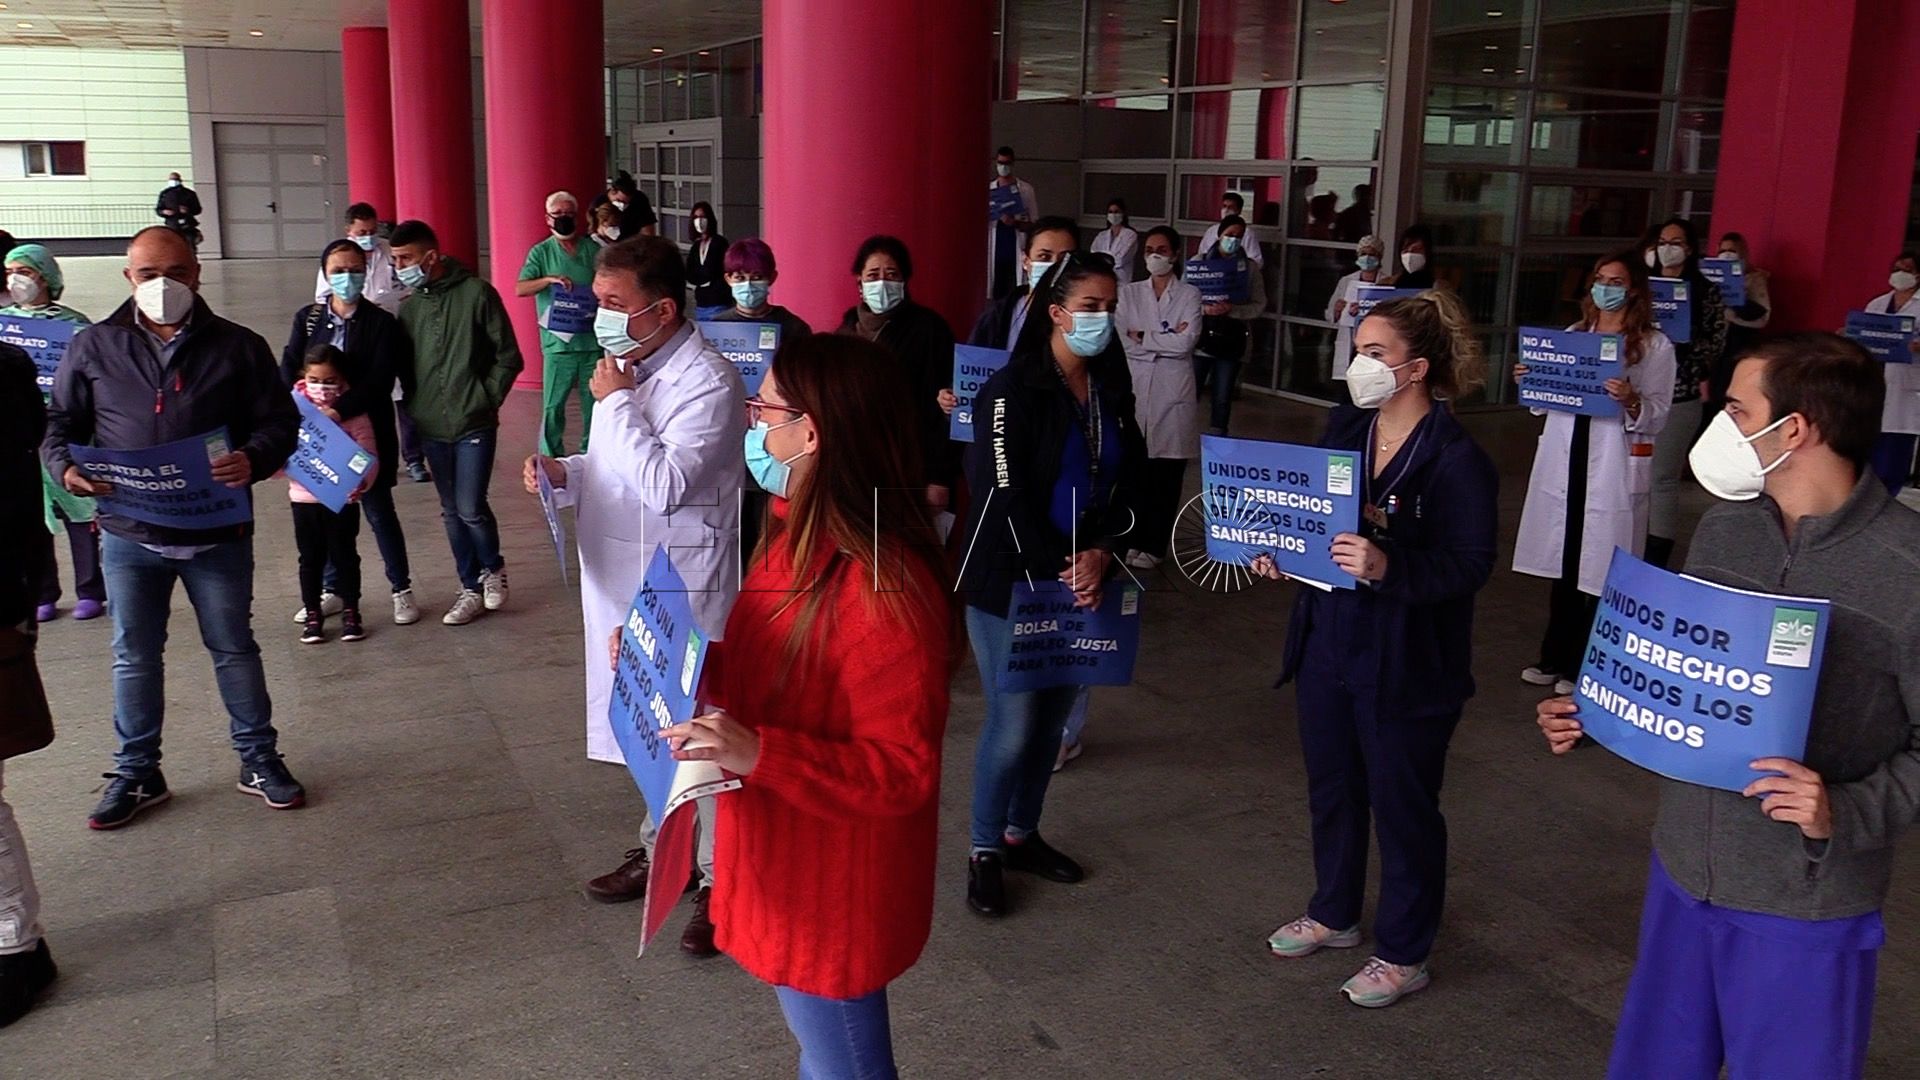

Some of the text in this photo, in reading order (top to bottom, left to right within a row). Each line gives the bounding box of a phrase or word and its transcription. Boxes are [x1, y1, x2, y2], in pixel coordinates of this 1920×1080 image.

[5, 324, 24, 334] AL
[0, 336, 67, 350] LTRATO DE
[723, 339, 746, 348] POR
[1522, 336, 1555, 349] NO AL
[722, 352, 763, 362] ECHOS
[1523, 350, 1602, 366] MALTRATO DEL
[739, 366, 758, 376] OS
[961, 364, 995, 377] UNID
[1529, 365, 1597, 380] GESA A SUS
[1522, 376, 1609, 396] PROFESIONALES
[1522, 389, 1583, 407] SANITARIOS
[307, 421, 327, 442] UNA
[311, 441, 326, 455] DE
[993, 398, 1010, 488] HELLY HANSEN
[84, 463, 183, 477] CONTRA EL
[309, 457, 339, 485] JUSTA
[1208, 461, 1271, 482] UNIDOS
[1277, 470, 1310, 487] POR
[1210, 483, 1333, 515] LOS DERECHOS
[1210, 503, 1326, 535] DE TODOS LOS
[1211, 525, 1306, 553] SANITARIOS
[640, 580, 676, 643] POR UNA
[1017, 602, 1045, 615] POR
[1013, 619, 1086, 636] BOLSA DE
[1603, 584, 1730, 653] UNIDOS POR
[627, 608, 669, 679] BOLSA DE
[1012, 637, 1119, 654] EMPLEO JUSTA
[1008, 655, 1098, 672] PARA TODOS
[1595, 615, 1773, 697] LOS DERECHOS
[620, 639, 673, 745] EMPLEO JUST
[1588, 645, 1754, 727] DE TODOS LOS
[614, 671, 660, 762] PARA TODOS
[1580, 674, 1706, 748] SANITARIOS
